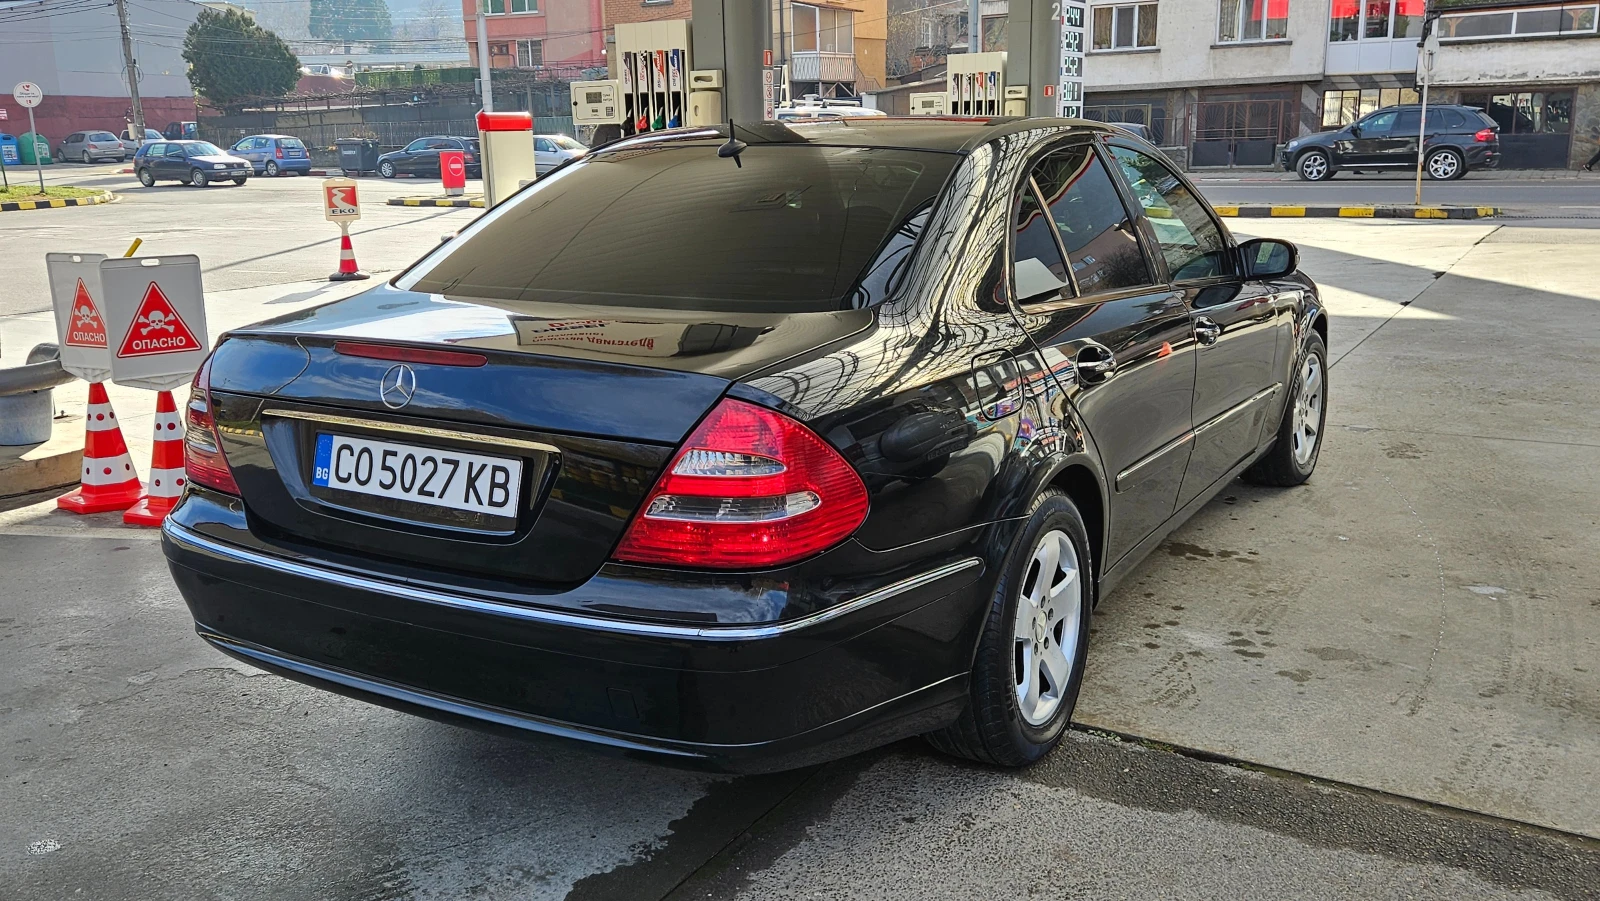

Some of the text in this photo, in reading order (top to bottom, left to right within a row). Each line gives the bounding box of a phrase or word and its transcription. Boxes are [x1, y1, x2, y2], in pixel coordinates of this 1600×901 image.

[1051, 2, 1061, 21] 2
[73, 331, 106, 343] ОПАСНО
[132, 336, 186, 350] ОПАСНО
[315, 466, 329, 480] BG
[379, 449, 460, 499] 5027
[463, 461, 510, 508] KB
